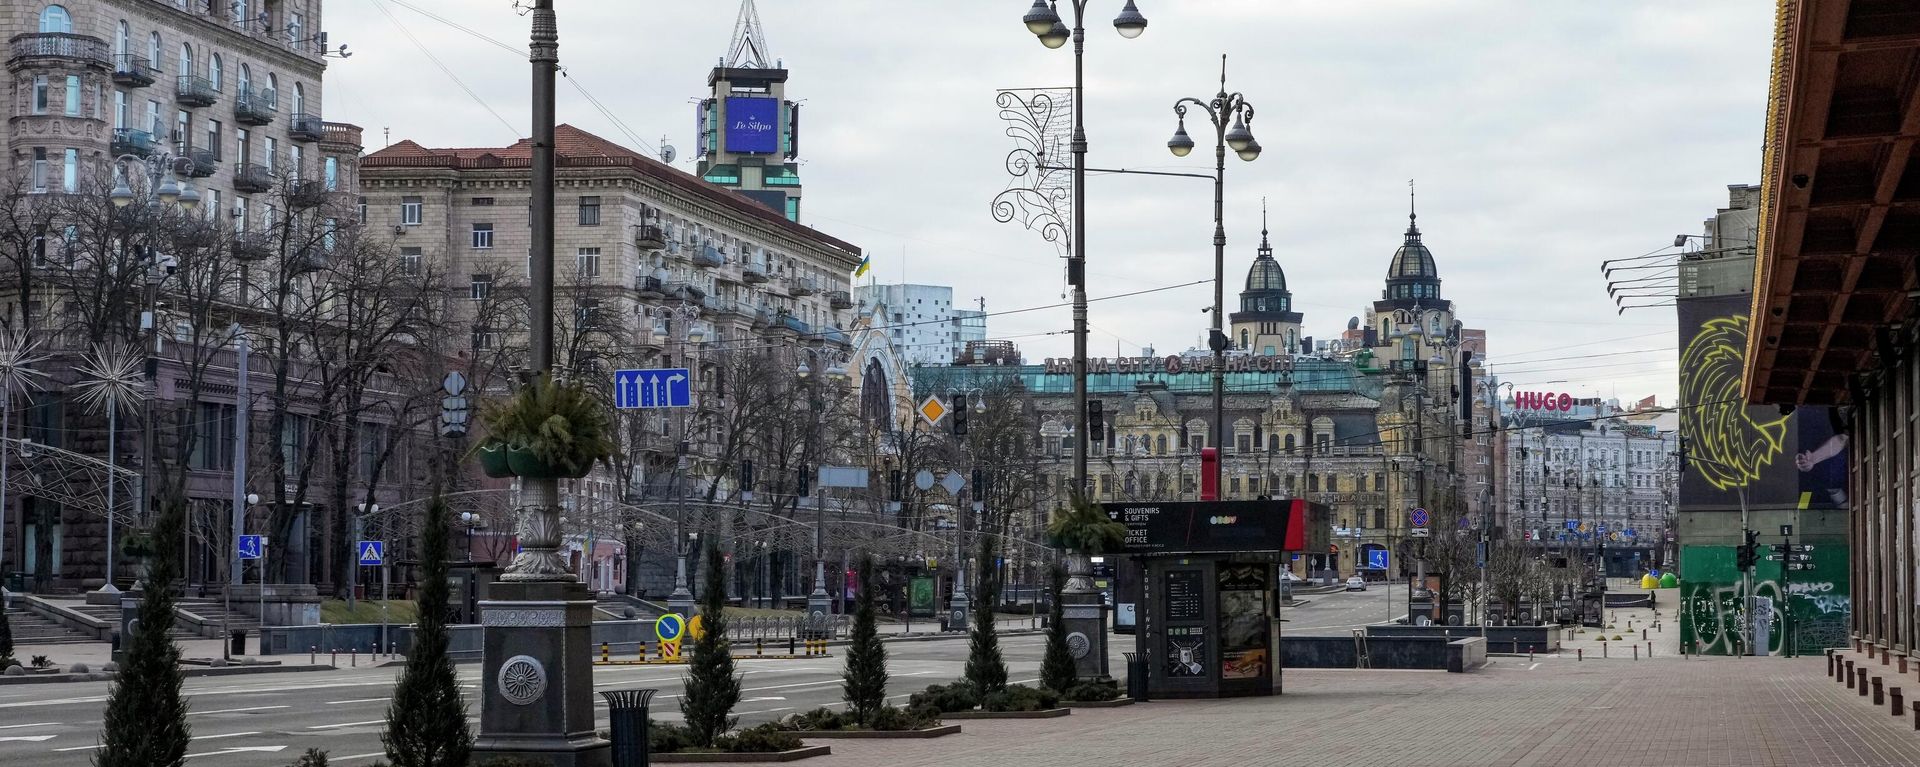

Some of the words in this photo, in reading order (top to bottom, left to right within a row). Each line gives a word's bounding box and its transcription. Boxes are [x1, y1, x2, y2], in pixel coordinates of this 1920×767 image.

[748, 121, 772, 132] Silpo
[1115, 356, 1161, 373] CITY
[1187, 356, 1252, 372] АРНА
[1515, 391, 1572, 411] HUGO
